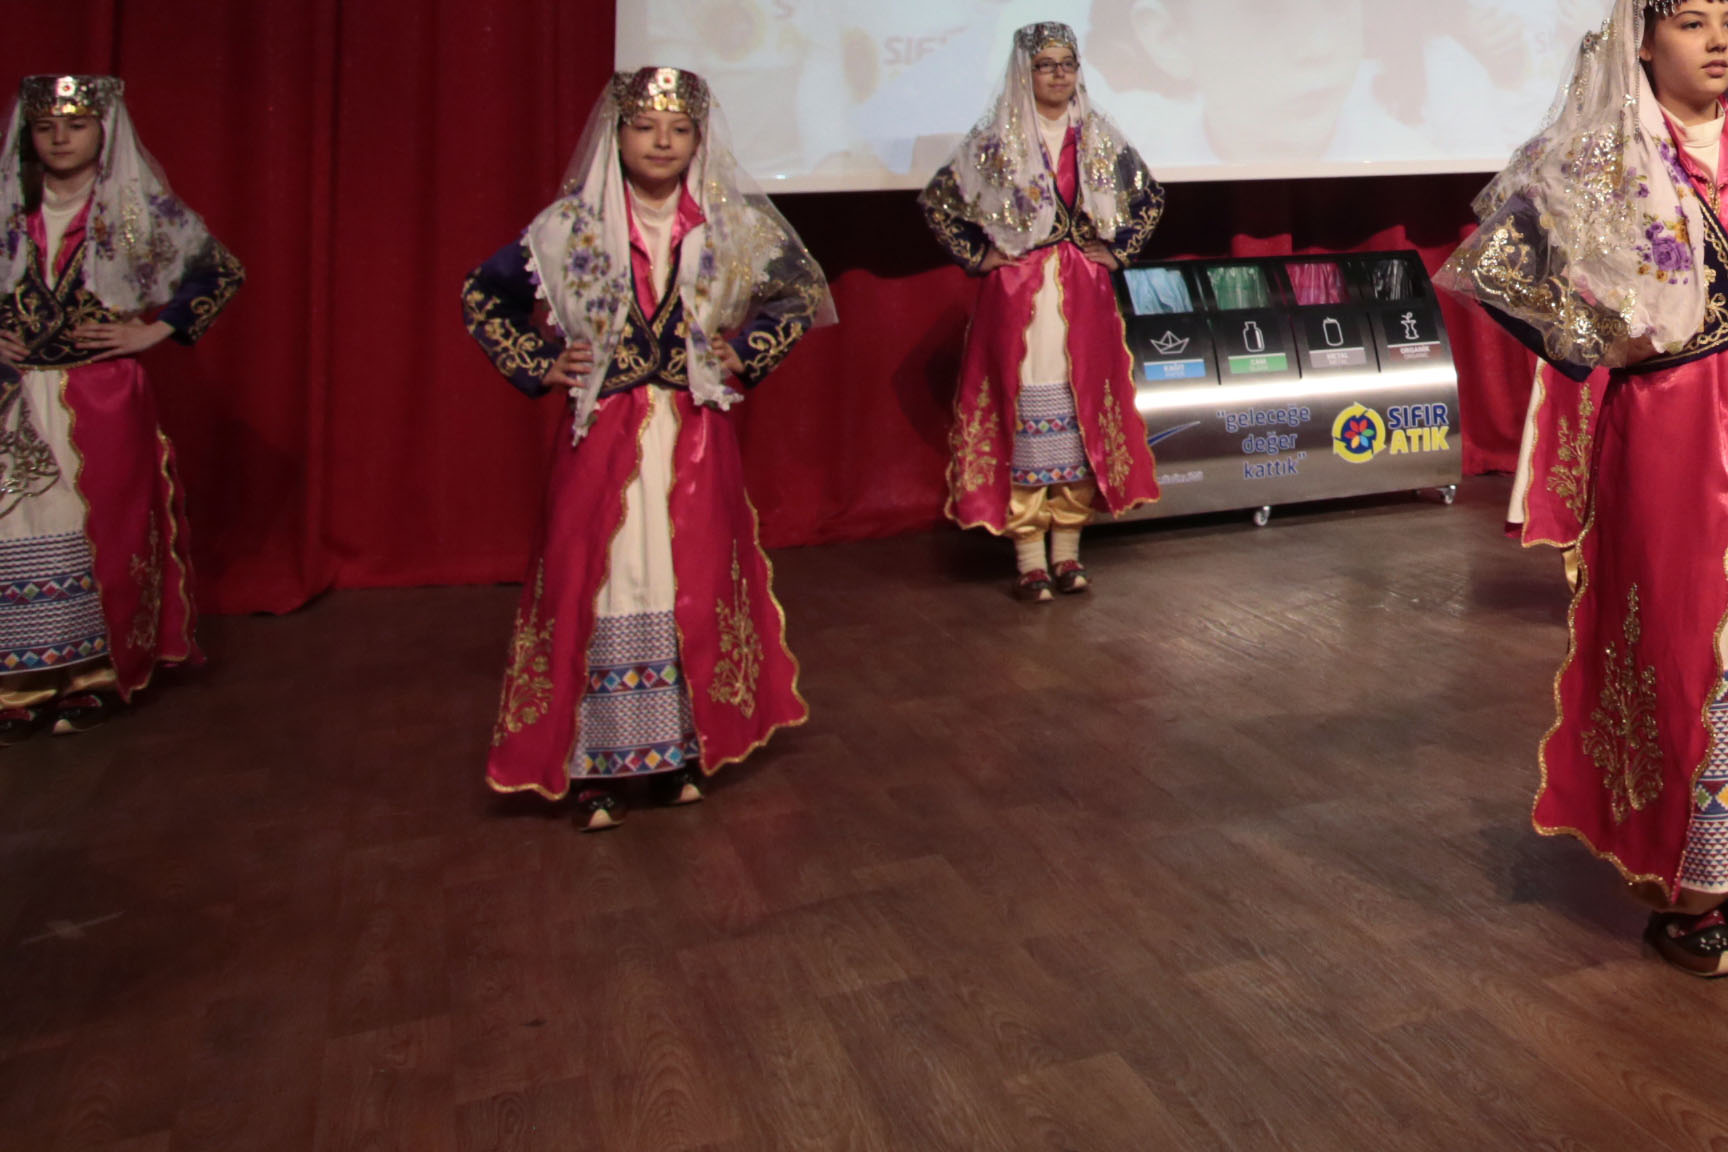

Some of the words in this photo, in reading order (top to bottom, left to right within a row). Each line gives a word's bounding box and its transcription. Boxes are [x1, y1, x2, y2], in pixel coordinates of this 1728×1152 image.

[1388, 402, 1450, 429] SIFIR
[1242, 431, 1298, 454] değer
[1389, 425, 1450, 455] ATIK
